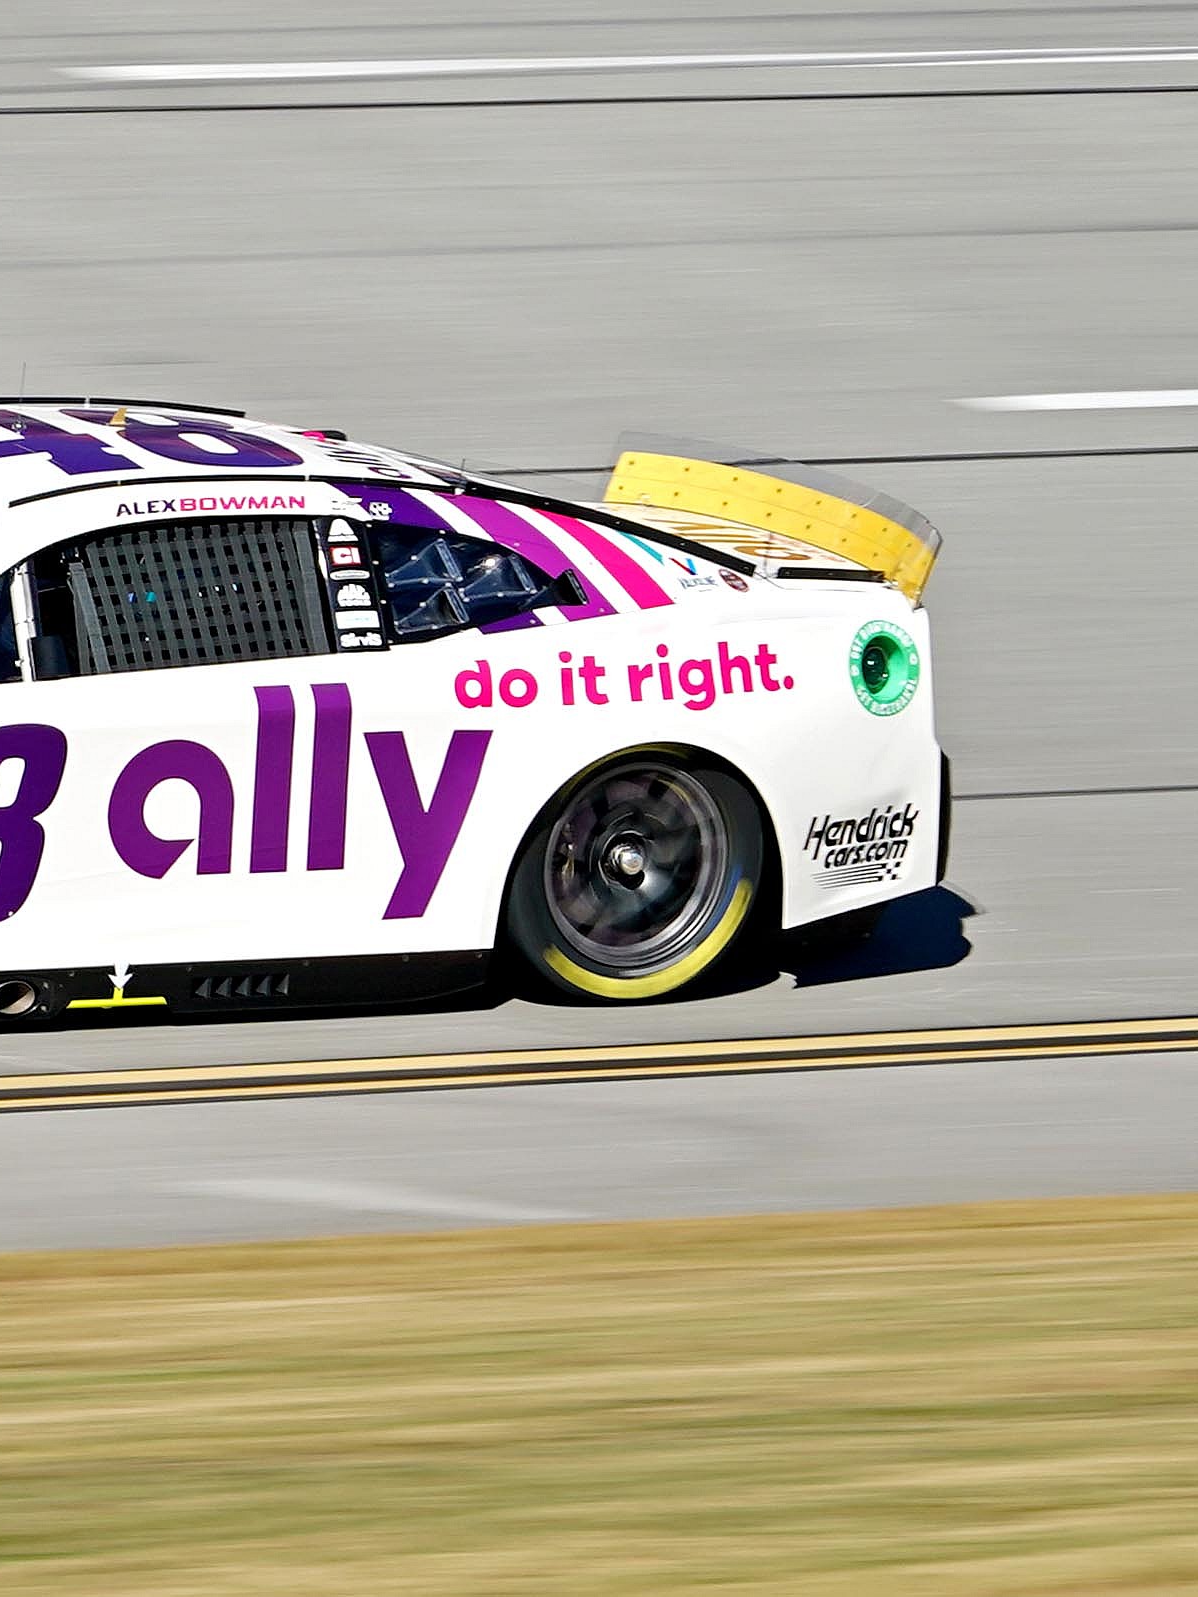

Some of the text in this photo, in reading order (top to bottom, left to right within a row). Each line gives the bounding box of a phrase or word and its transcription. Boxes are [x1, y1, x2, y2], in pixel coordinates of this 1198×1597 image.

[454, 641, 795, 711] do it right.
[106, 682, 495, 921] ally
[802, 803, 920, 860] Hendrick
[824, 839, 909, 869] cars.com
